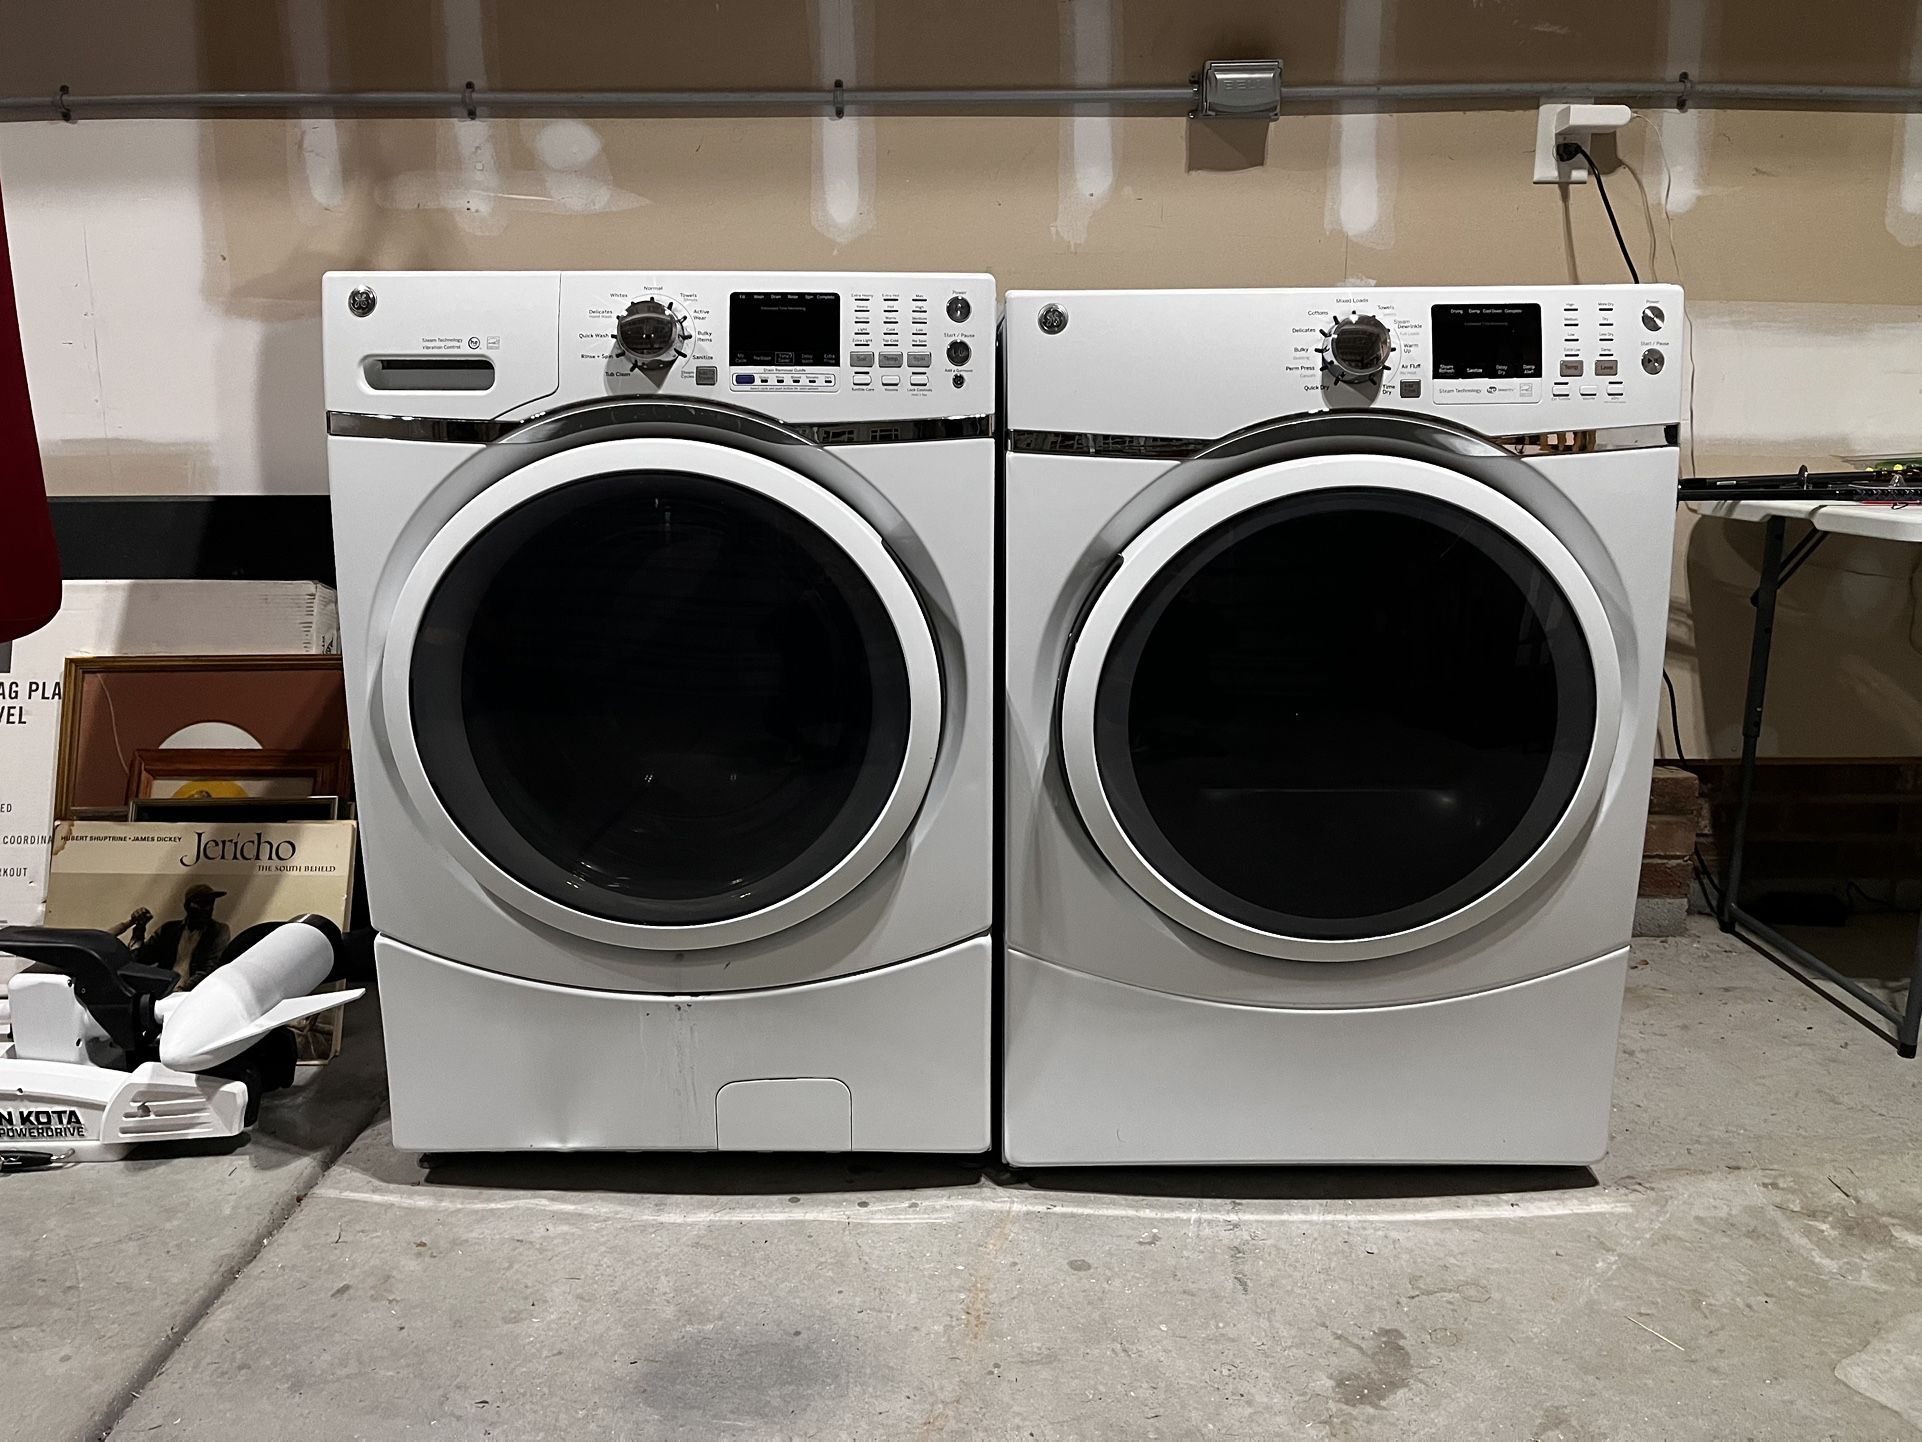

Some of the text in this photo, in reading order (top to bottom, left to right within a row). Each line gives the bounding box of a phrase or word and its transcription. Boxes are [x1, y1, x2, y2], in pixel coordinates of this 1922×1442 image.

[28, 681, 62, 700] PLA
[0, 803, 12, 813] ED
[180, 831, 296, 867] Jericho
[0, 867, 28, 877] KOUT
[0, 1110, 83, 1126] N KOTA
[0, 1126, 85, 1138] POWERDRIVE
